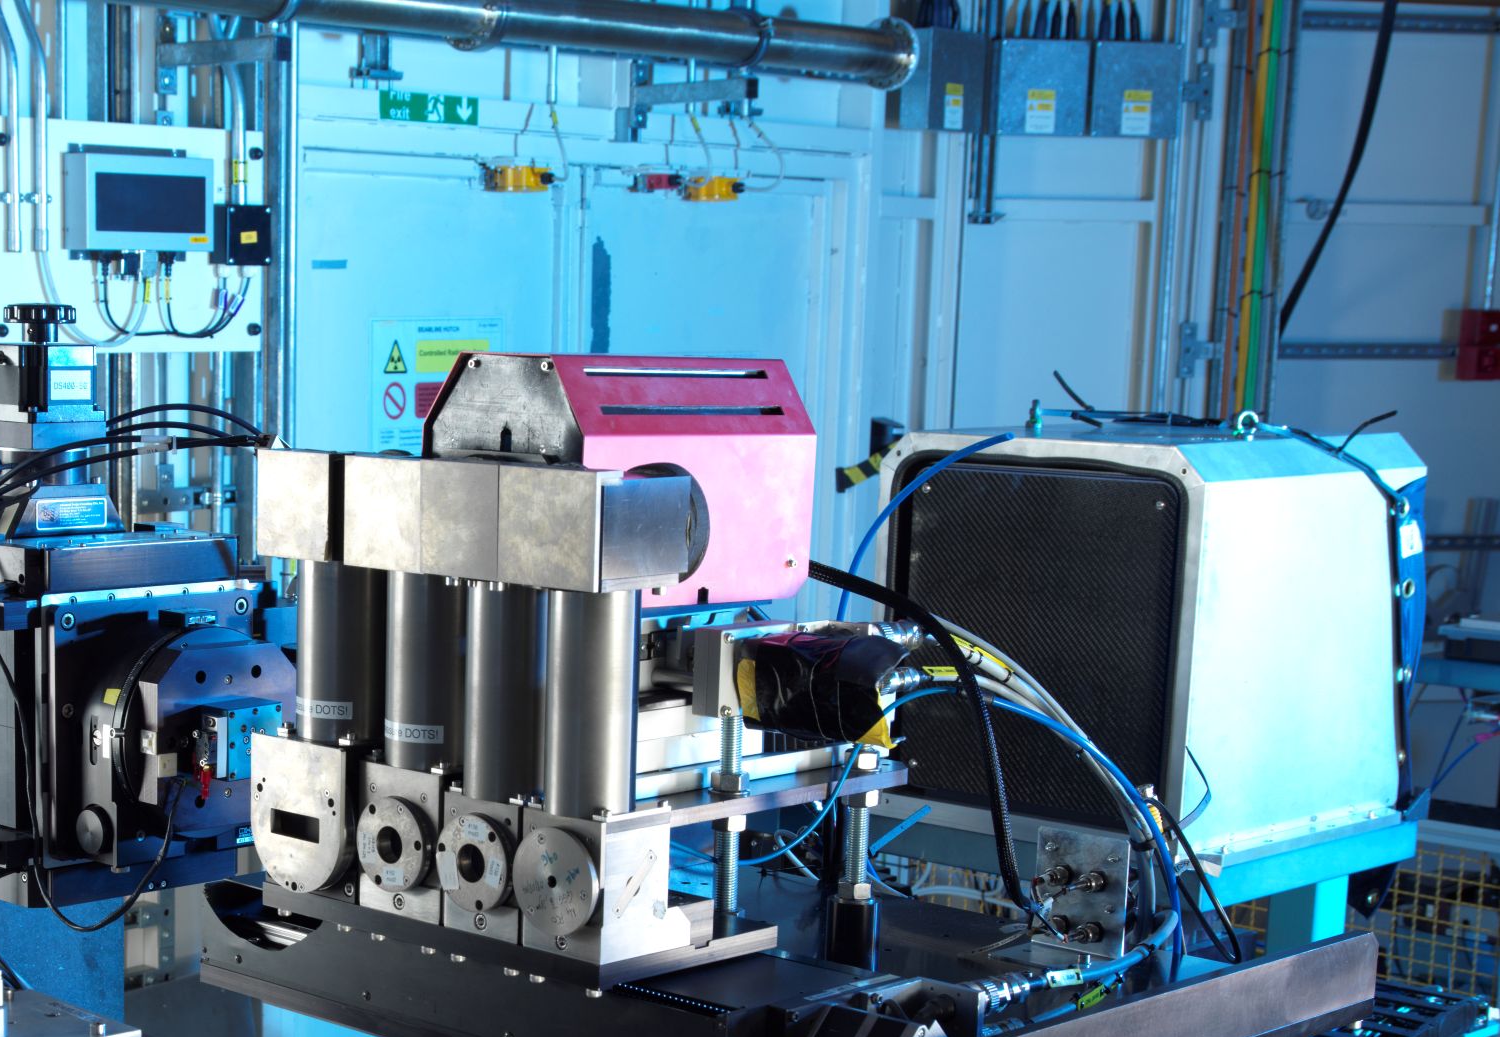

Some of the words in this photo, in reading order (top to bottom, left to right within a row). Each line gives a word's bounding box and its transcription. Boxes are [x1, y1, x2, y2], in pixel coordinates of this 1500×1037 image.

[389, 106, 410, 120] exit
[315, 704, 348, 716] DOTS!
[405, 728, 439, 739] DOTS!
